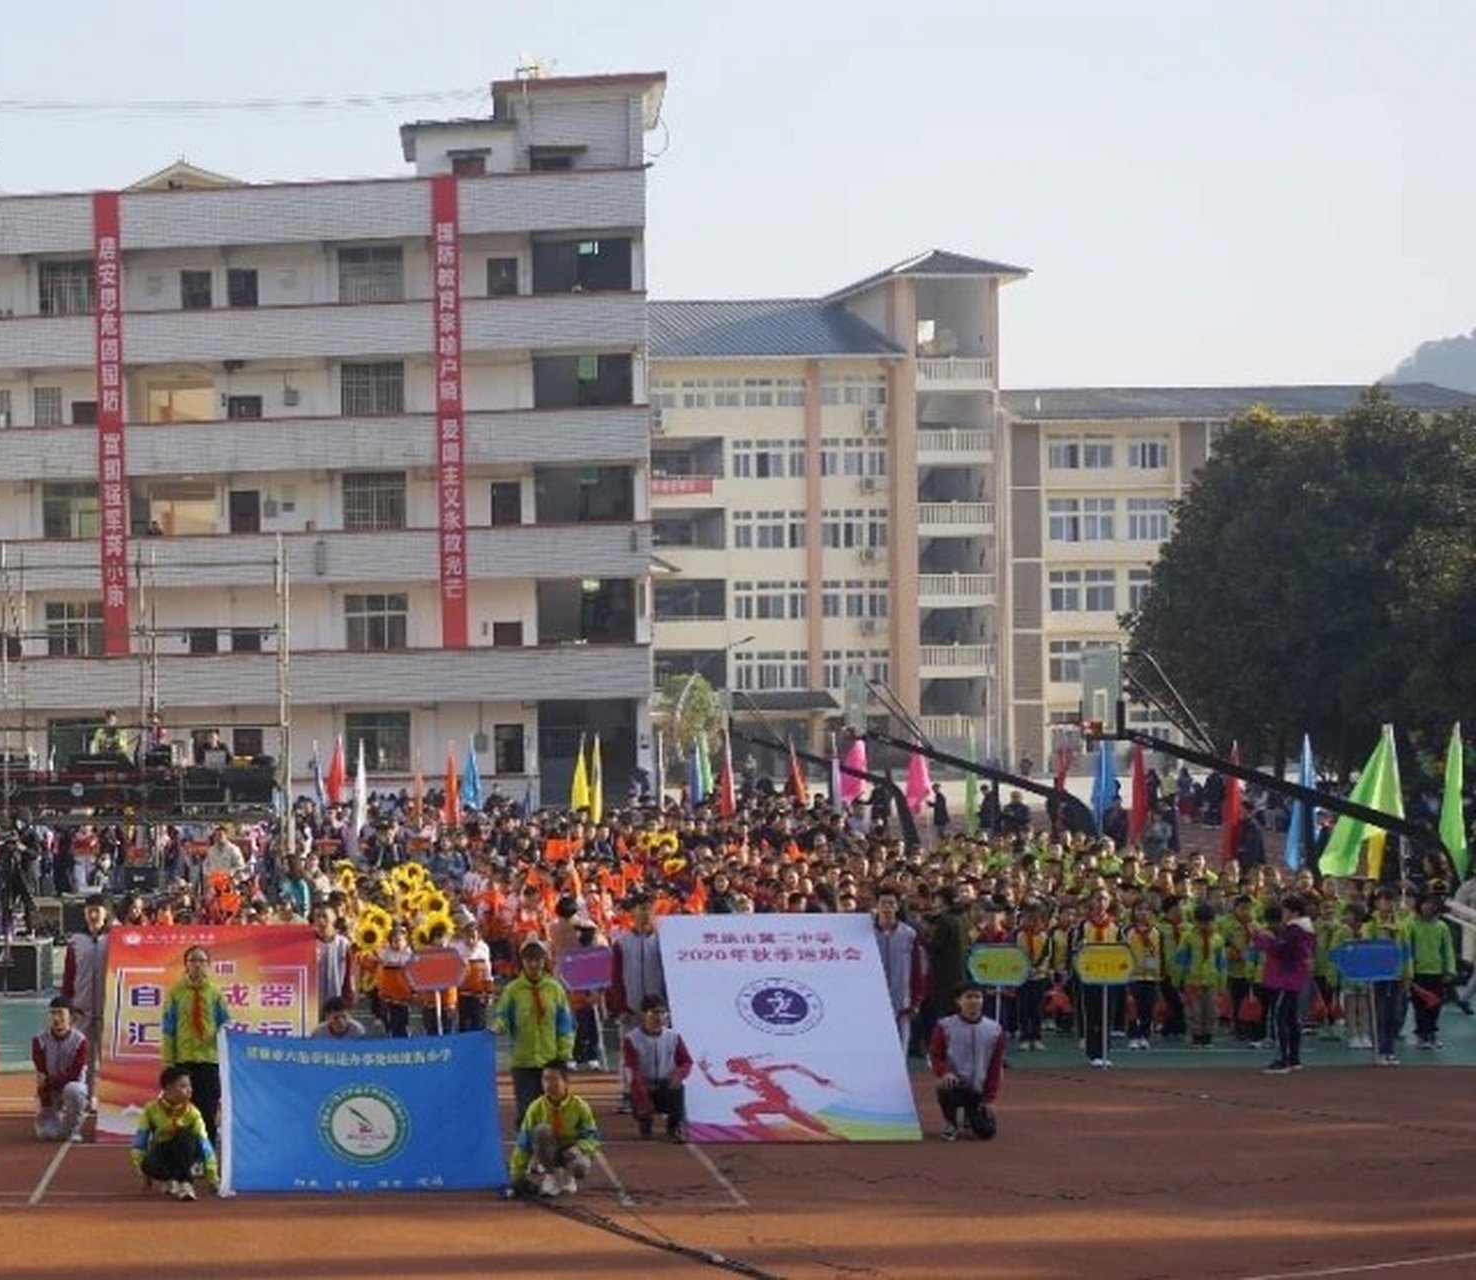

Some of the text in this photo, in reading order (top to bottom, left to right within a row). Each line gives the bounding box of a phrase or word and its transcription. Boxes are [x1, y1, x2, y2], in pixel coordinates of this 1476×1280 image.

[98, 237, 125, 607] 居安思危固国防 富国强军奔小康
[437, 222, 463, 598] 国防教育家喻户晓 爱国主义永放光芒
[131, 984, 293, 1007] 自成器
[677, 946, 862, 962] 2020年秋季运动会
